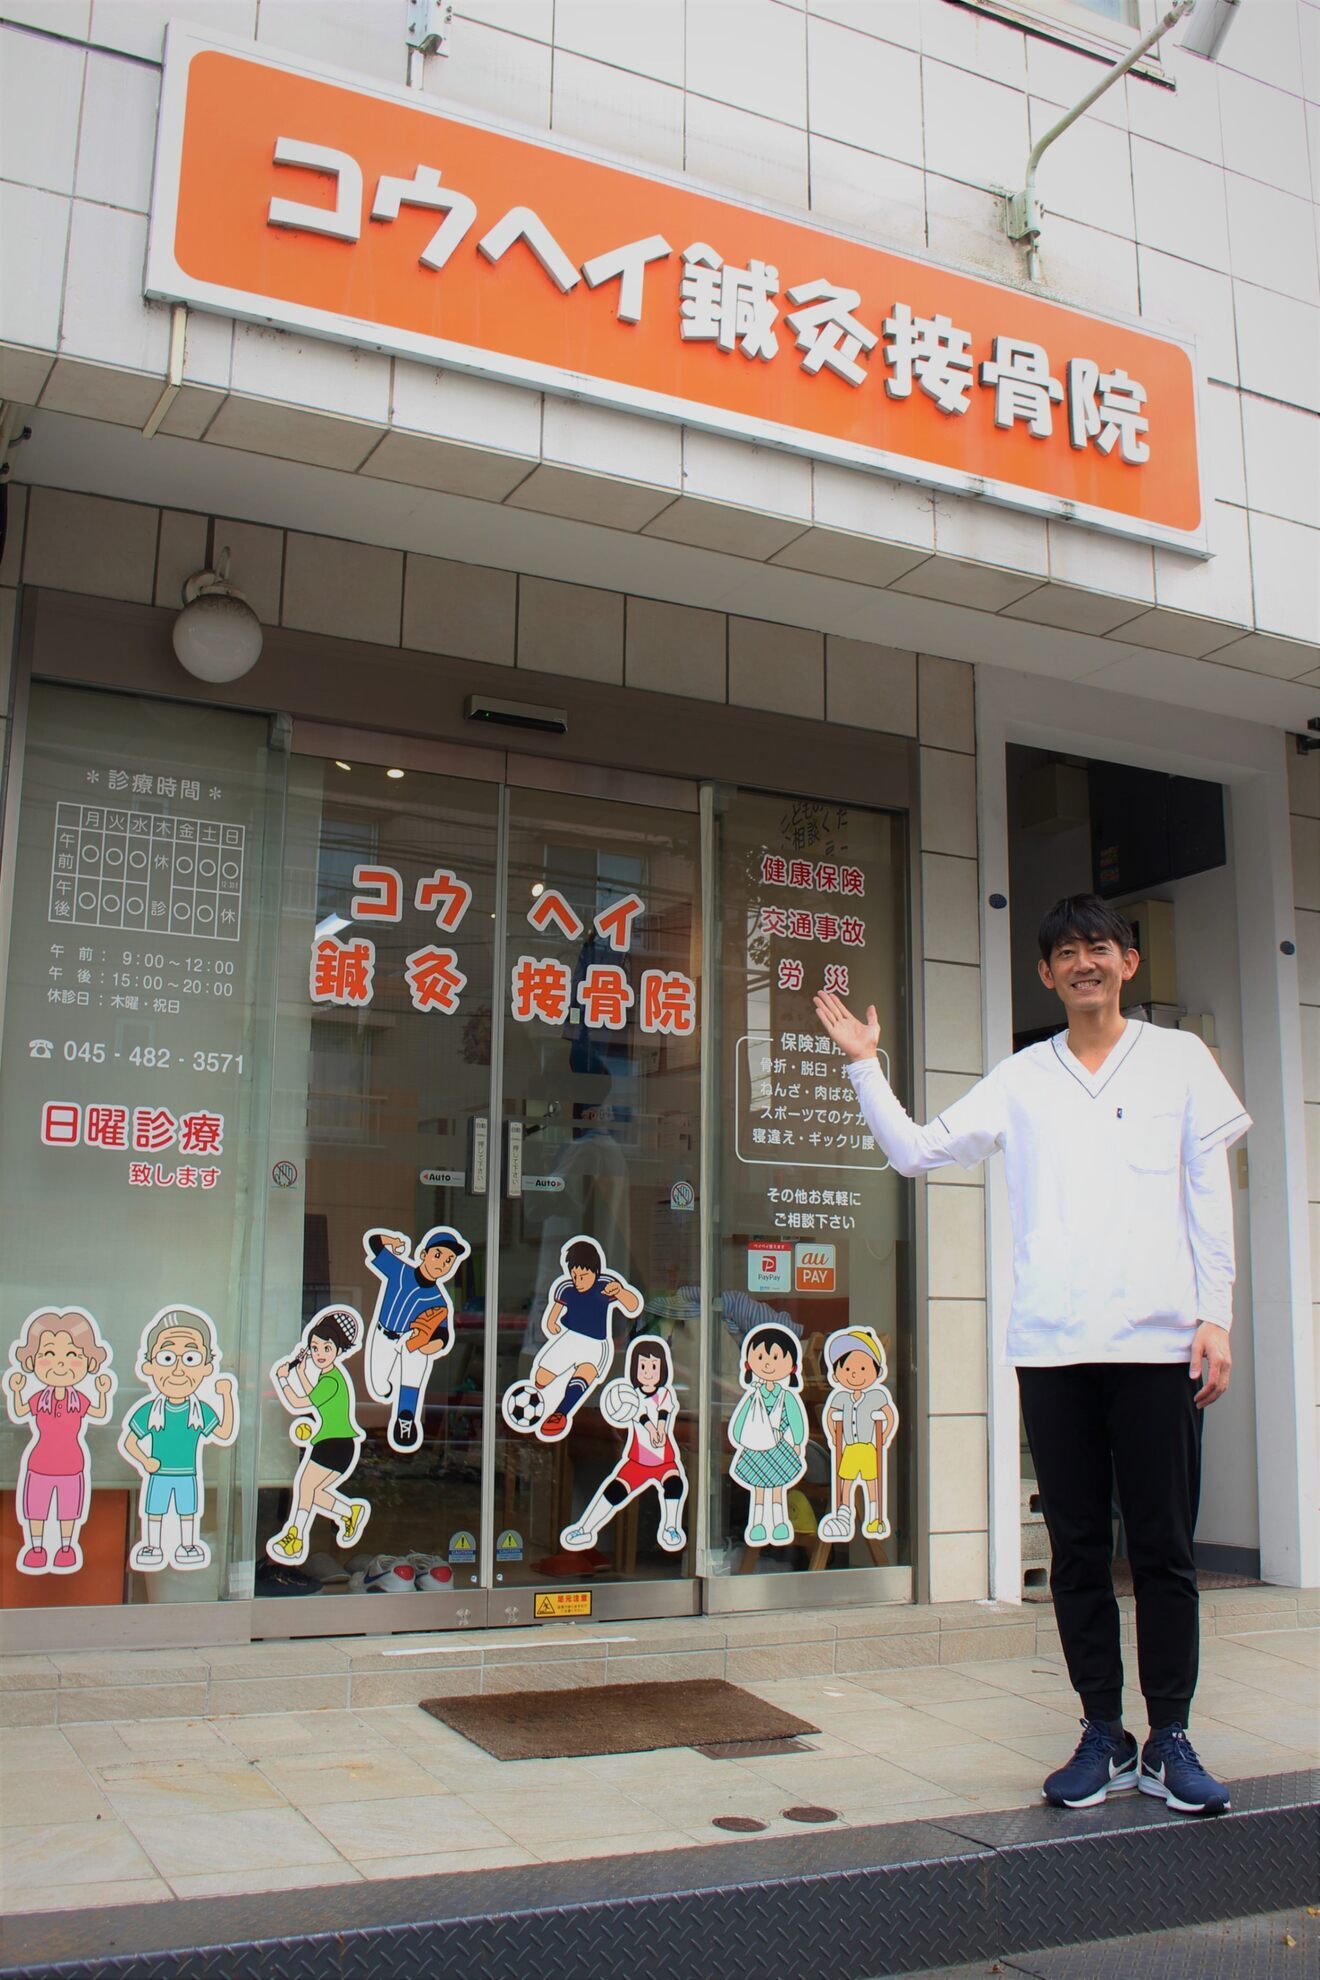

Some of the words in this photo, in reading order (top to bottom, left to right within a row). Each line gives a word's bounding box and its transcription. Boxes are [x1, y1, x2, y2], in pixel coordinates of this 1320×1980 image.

[267, 135, 1150, 464] コウヘイ鍼灸接骨院
[85, 811, 100, 827] 月
[108, 814, 124, 830] 火
[132, 818, 148, 832] 水
[156, 820, 172, 836] 木
[179, 823, 195, 839] 金
[202, 827, 217, 842] 土
[225, 830, 239, 844] 日
[58, 832, 76, 870] 午前
[761, 855, 865, 897] 健康保険
[54, 879, 72, 917] 午後
[220, 909, 237, 925] 休
[761, 906, 865, 947] 交通事故
[43, 1103, 223, 1154] 日曜診療
[130, 1162, 219, 1188] 致します
[429, 1173, 451, 1182] Auto
[535, 1179, 556, 1188] Auto
[766, 1187, 862, 1207] その他お気軽に
[774, 1211, 856, 1230] ご相談下さい
[801, 1252, 830, 1266] au
[758, 1273, 781, 1282] PayPay
[803, 1269, 828, 1284] PAY
